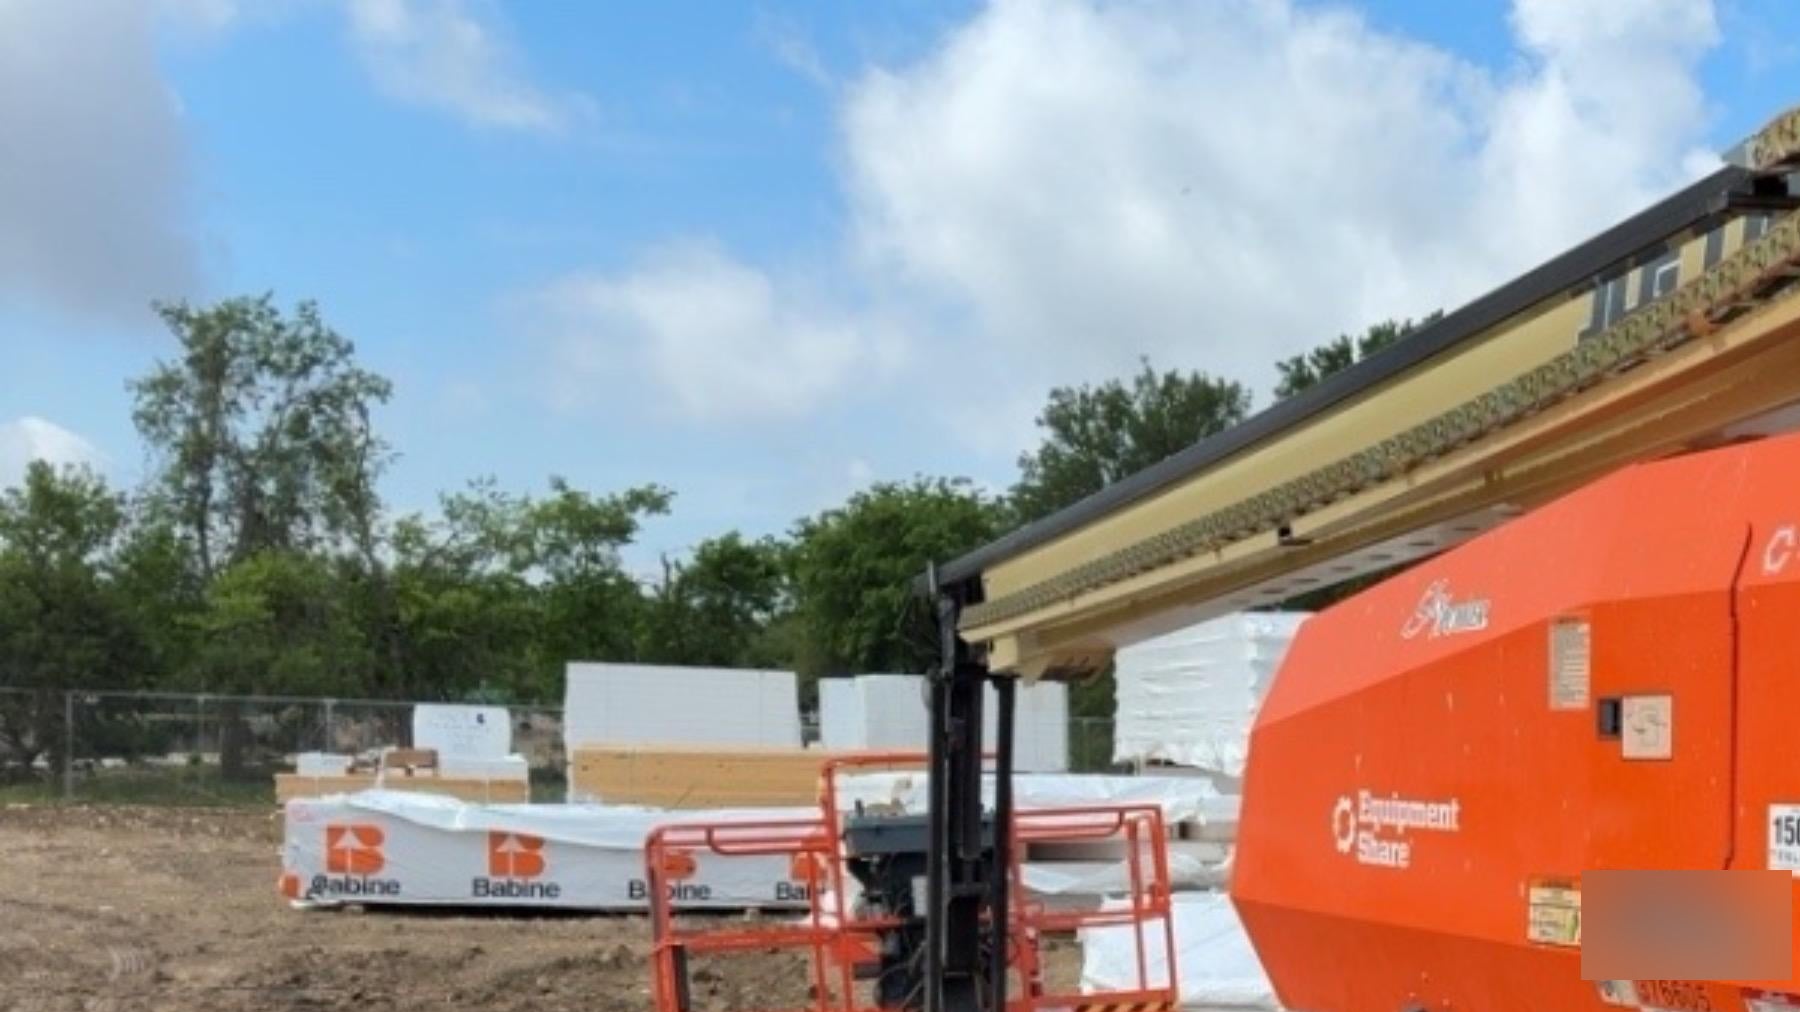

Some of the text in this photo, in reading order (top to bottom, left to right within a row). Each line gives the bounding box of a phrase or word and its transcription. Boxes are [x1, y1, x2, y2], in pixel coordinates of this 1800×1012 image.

[1358, 789, 1460, 834] Equipment
[1357, 830, 1411, 868] Share
[472, 876, 561, 899] Babine
